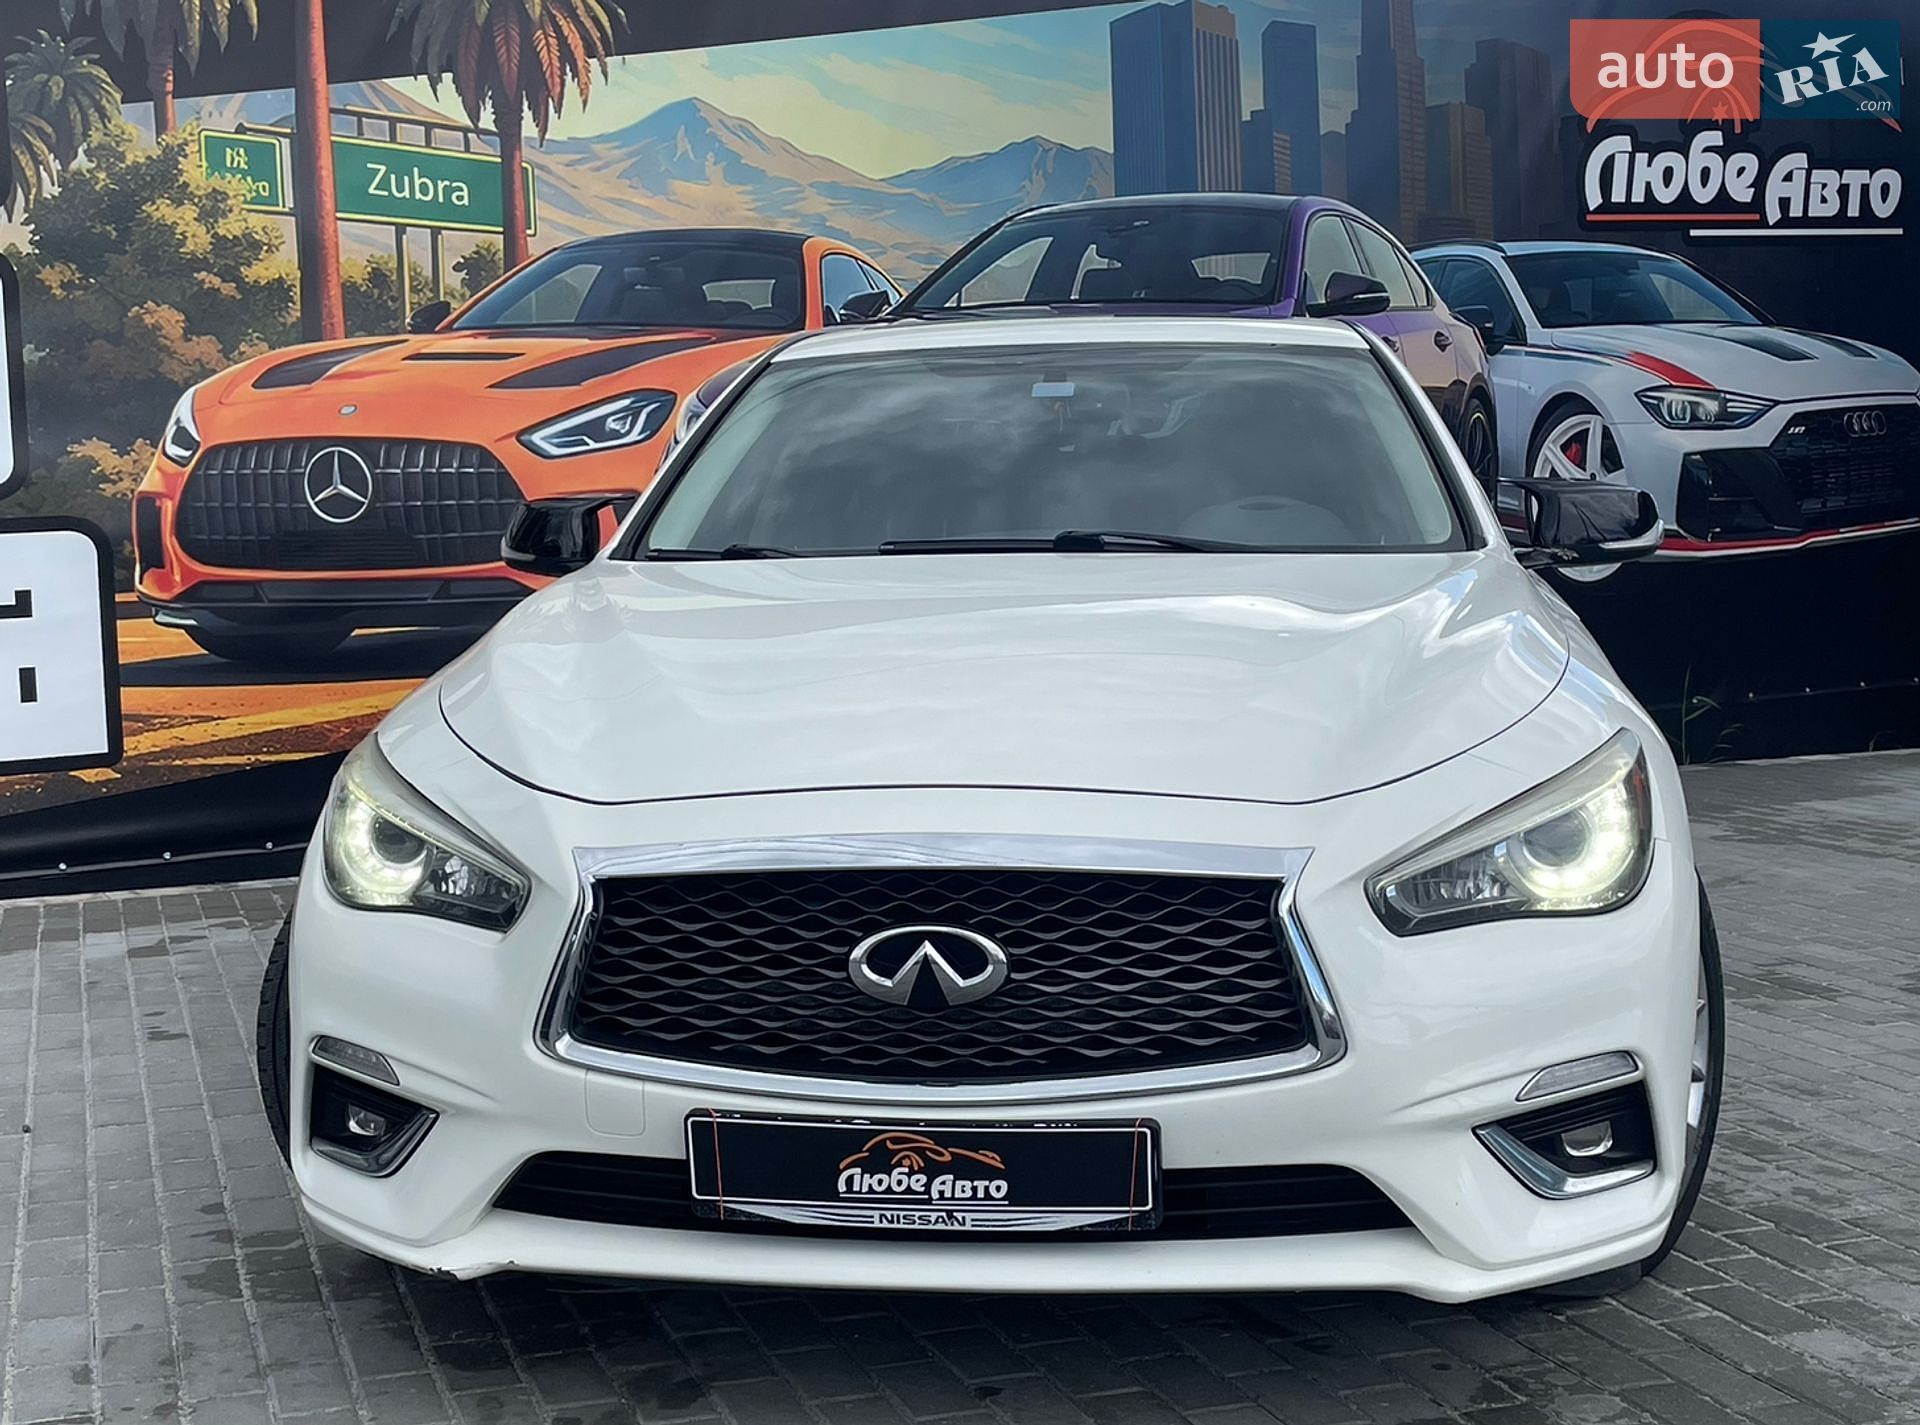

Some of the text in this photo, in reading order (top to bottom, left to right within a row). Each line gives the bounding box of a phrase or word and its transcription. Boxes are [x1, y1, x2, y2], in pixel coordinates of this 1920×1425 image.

[366, 162, 470, 207] Zubra
[1584, 130, 1903, 227] Любе Авто
[837, 1167, 1009, 1200] Любе Авто
[879, 1213, 966, 1227] NISSAN
